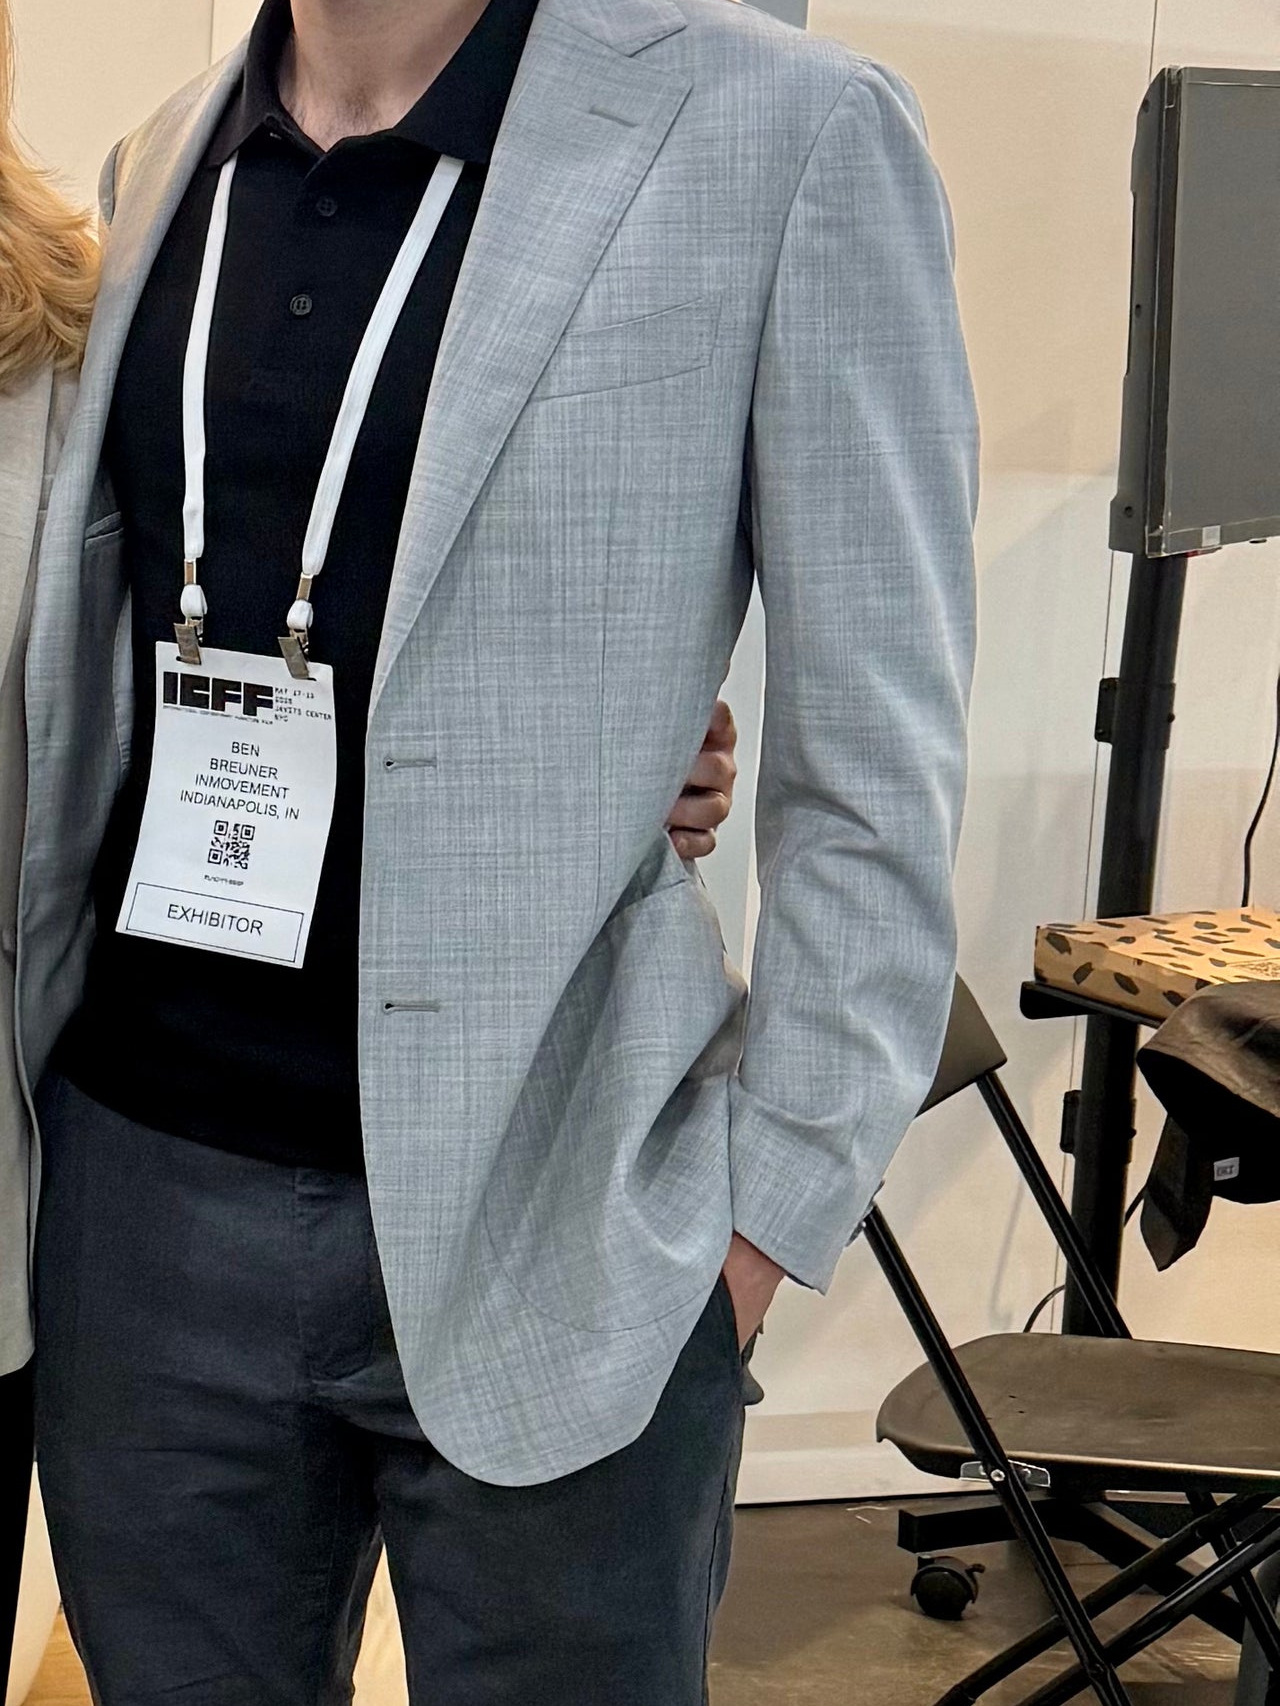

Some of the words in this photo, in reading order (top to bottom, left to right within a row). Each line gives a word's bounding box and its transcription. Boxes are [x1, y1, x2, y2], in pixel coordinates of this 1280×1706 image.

[231, 741, 260, 757] BEN
[209, 757, 278, 780] BREUNER
[195, 774, 290, 799] INMOVEMENT
[180, 790, 279, 819] INDIANAPOLIS,
[285, 807, 300, 820] IN
[167, 904, 263, 936] EXHIBITOR
